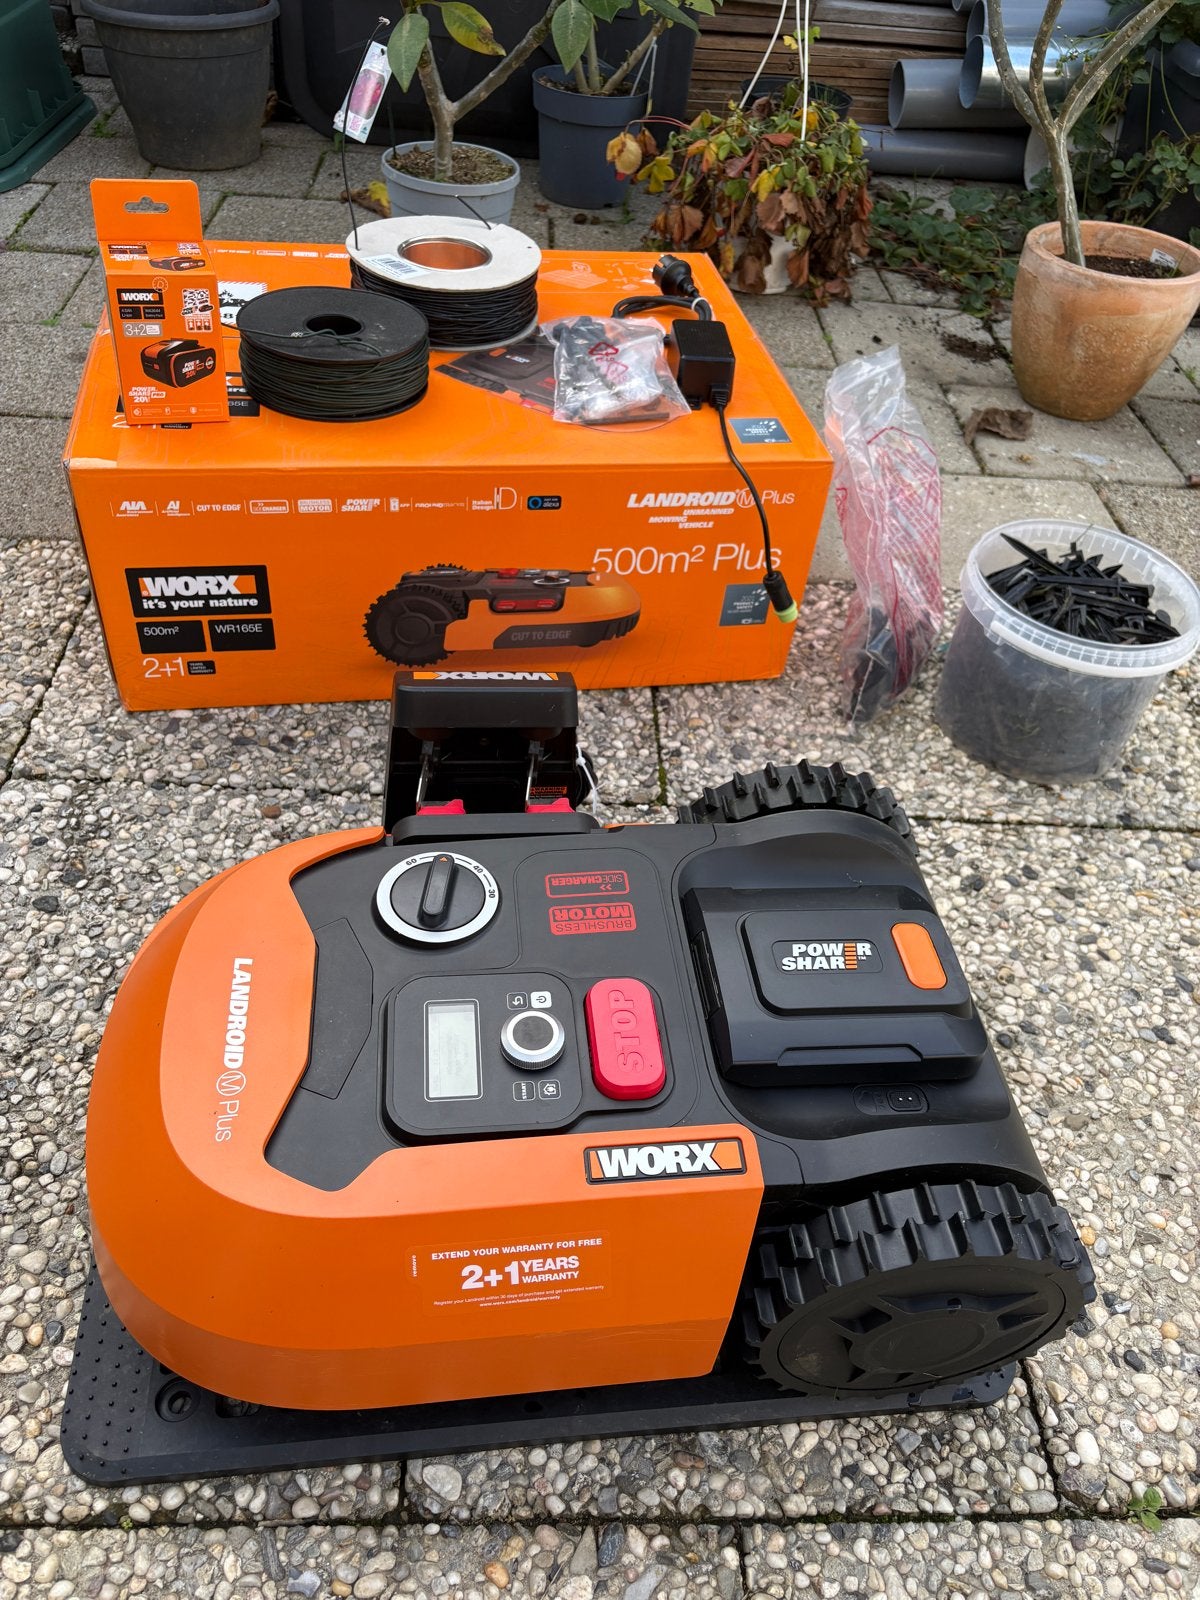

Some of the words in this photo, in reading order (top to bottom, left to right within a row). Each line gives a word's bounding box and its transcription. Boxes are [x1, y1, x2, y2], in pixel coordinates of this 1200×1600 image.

[125, 323, 146, 336] 3+2
[627, 491, 737, 508] LANDROID
[761, 490, 795, 505] Plus
[683, 508, 735, 516] UNMANNED
[678, 521, 714, 529] VEHICLE
[713, 543, 783, 572] Plus
[142, 575, 241, 597] WORX
[142, 598, 167, 610] it's
[170, 598, 205, 611] your
[209, 596, 259, 608] nature
[215, 624, 263, 634] WR165E
[143, 657, 184, 678] 2+1
[434, 671, 553, 681] WORX
[406, 858, 417, 866] 60
[473, 865, 484, 874] 40
[551, 874, 623, 886] SIDECHARGER
[488, 889, 496, 899] 30
[553, 905, 631, 922] MOTOR
[555, 920, 632, 932] BRUSHLESS
[792, 942, 872, 957] POWER
[223, 957, 254, 1069] LANDROID
[607, 989, 645, 1073] STOP
[219, 1072, 244, 1094] M
[215, 1100, 240, 1142] Plus
[597, 1142, 721, 1178] WORX
[431, 1250, 470, 1260] EXTEND
[473, 1247, 500, 1257] YOUR
[502, 1242, 554, 1254] WARRANTY
[556, 1240, 576, 1249] FOR
[578, 1238, 602, 1247] FREE
[461, 1260, 519, 1290] 2+1
[520, 1255, 580, 1272] YEARS
[522, 1271, 580, 1284] WARRANTY
